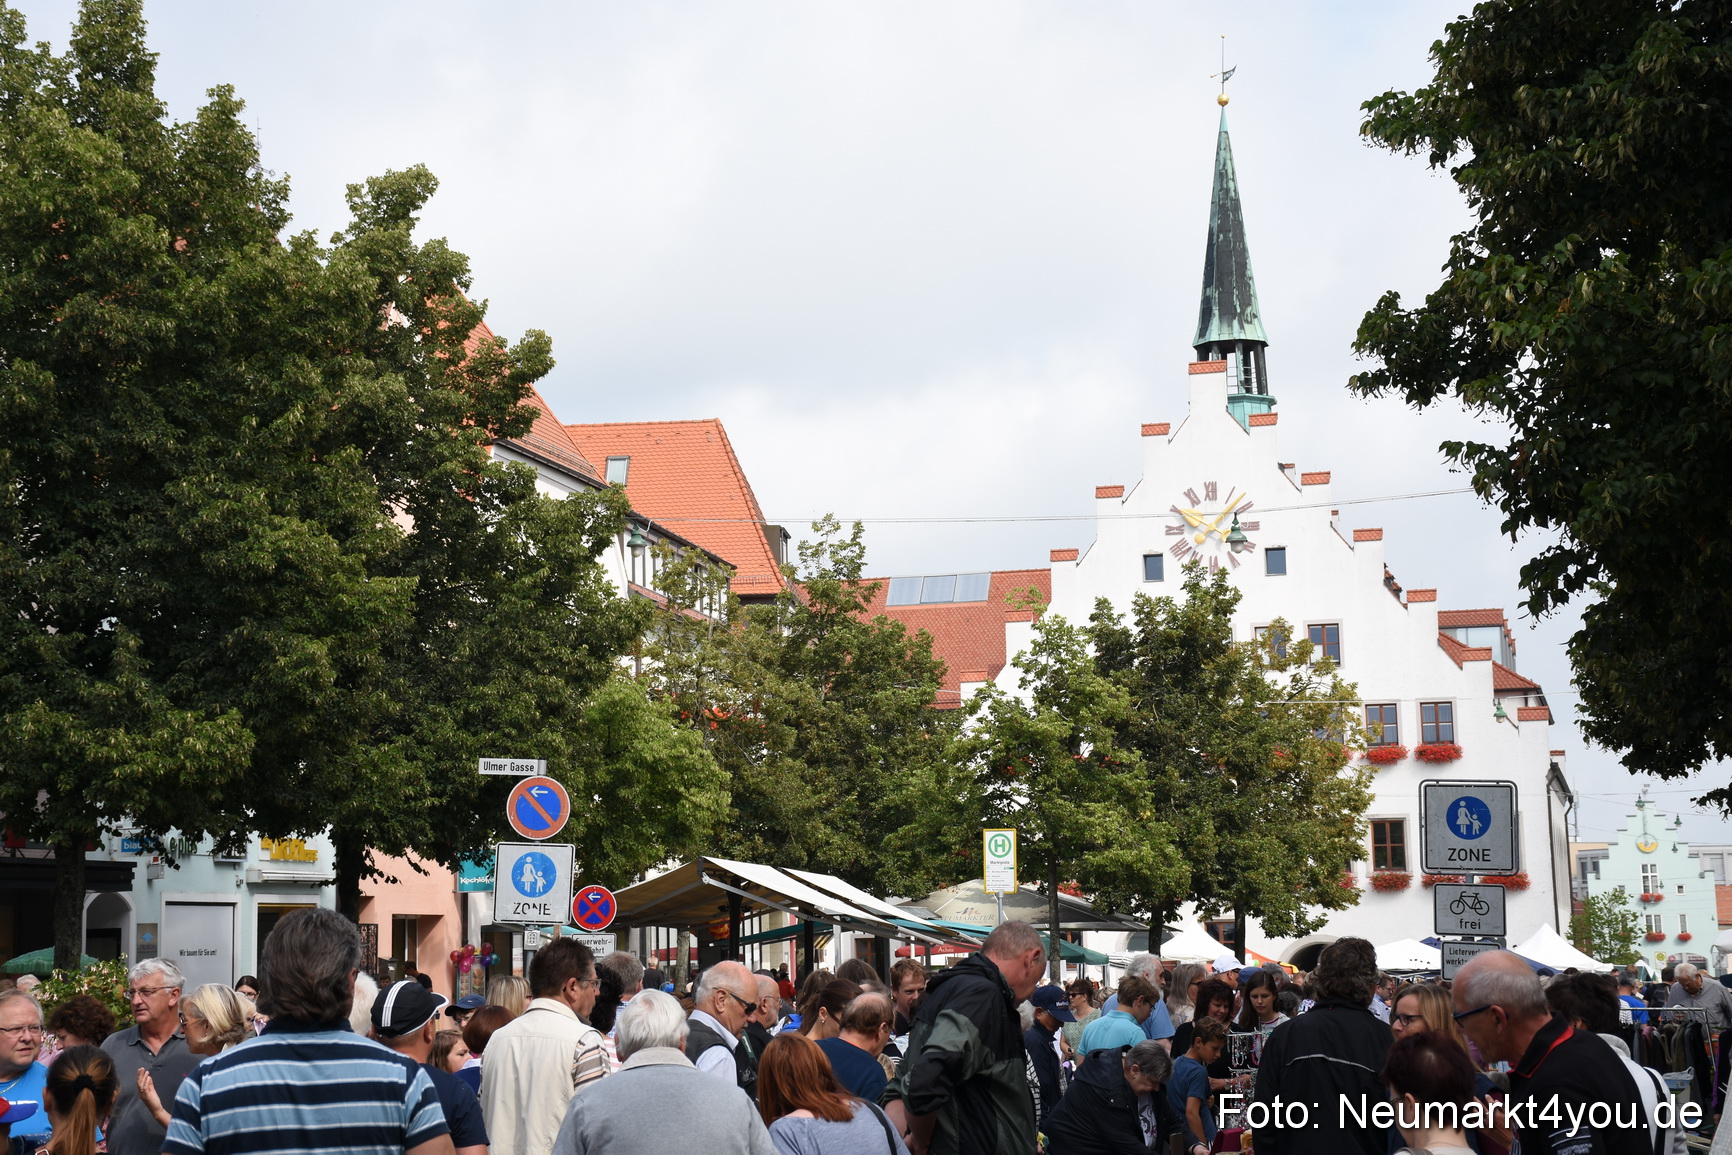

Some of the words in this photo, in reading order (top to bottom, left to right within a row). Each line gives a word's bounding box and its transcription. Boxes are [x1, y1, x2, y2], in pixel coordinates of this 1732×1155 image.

[483, 761, 508, 772] Ulmer
[510, 762, 535, 772] Gasse
[1447, 848, 1491, 862] ZONE
[1459, 918, 1481, 930] frei
